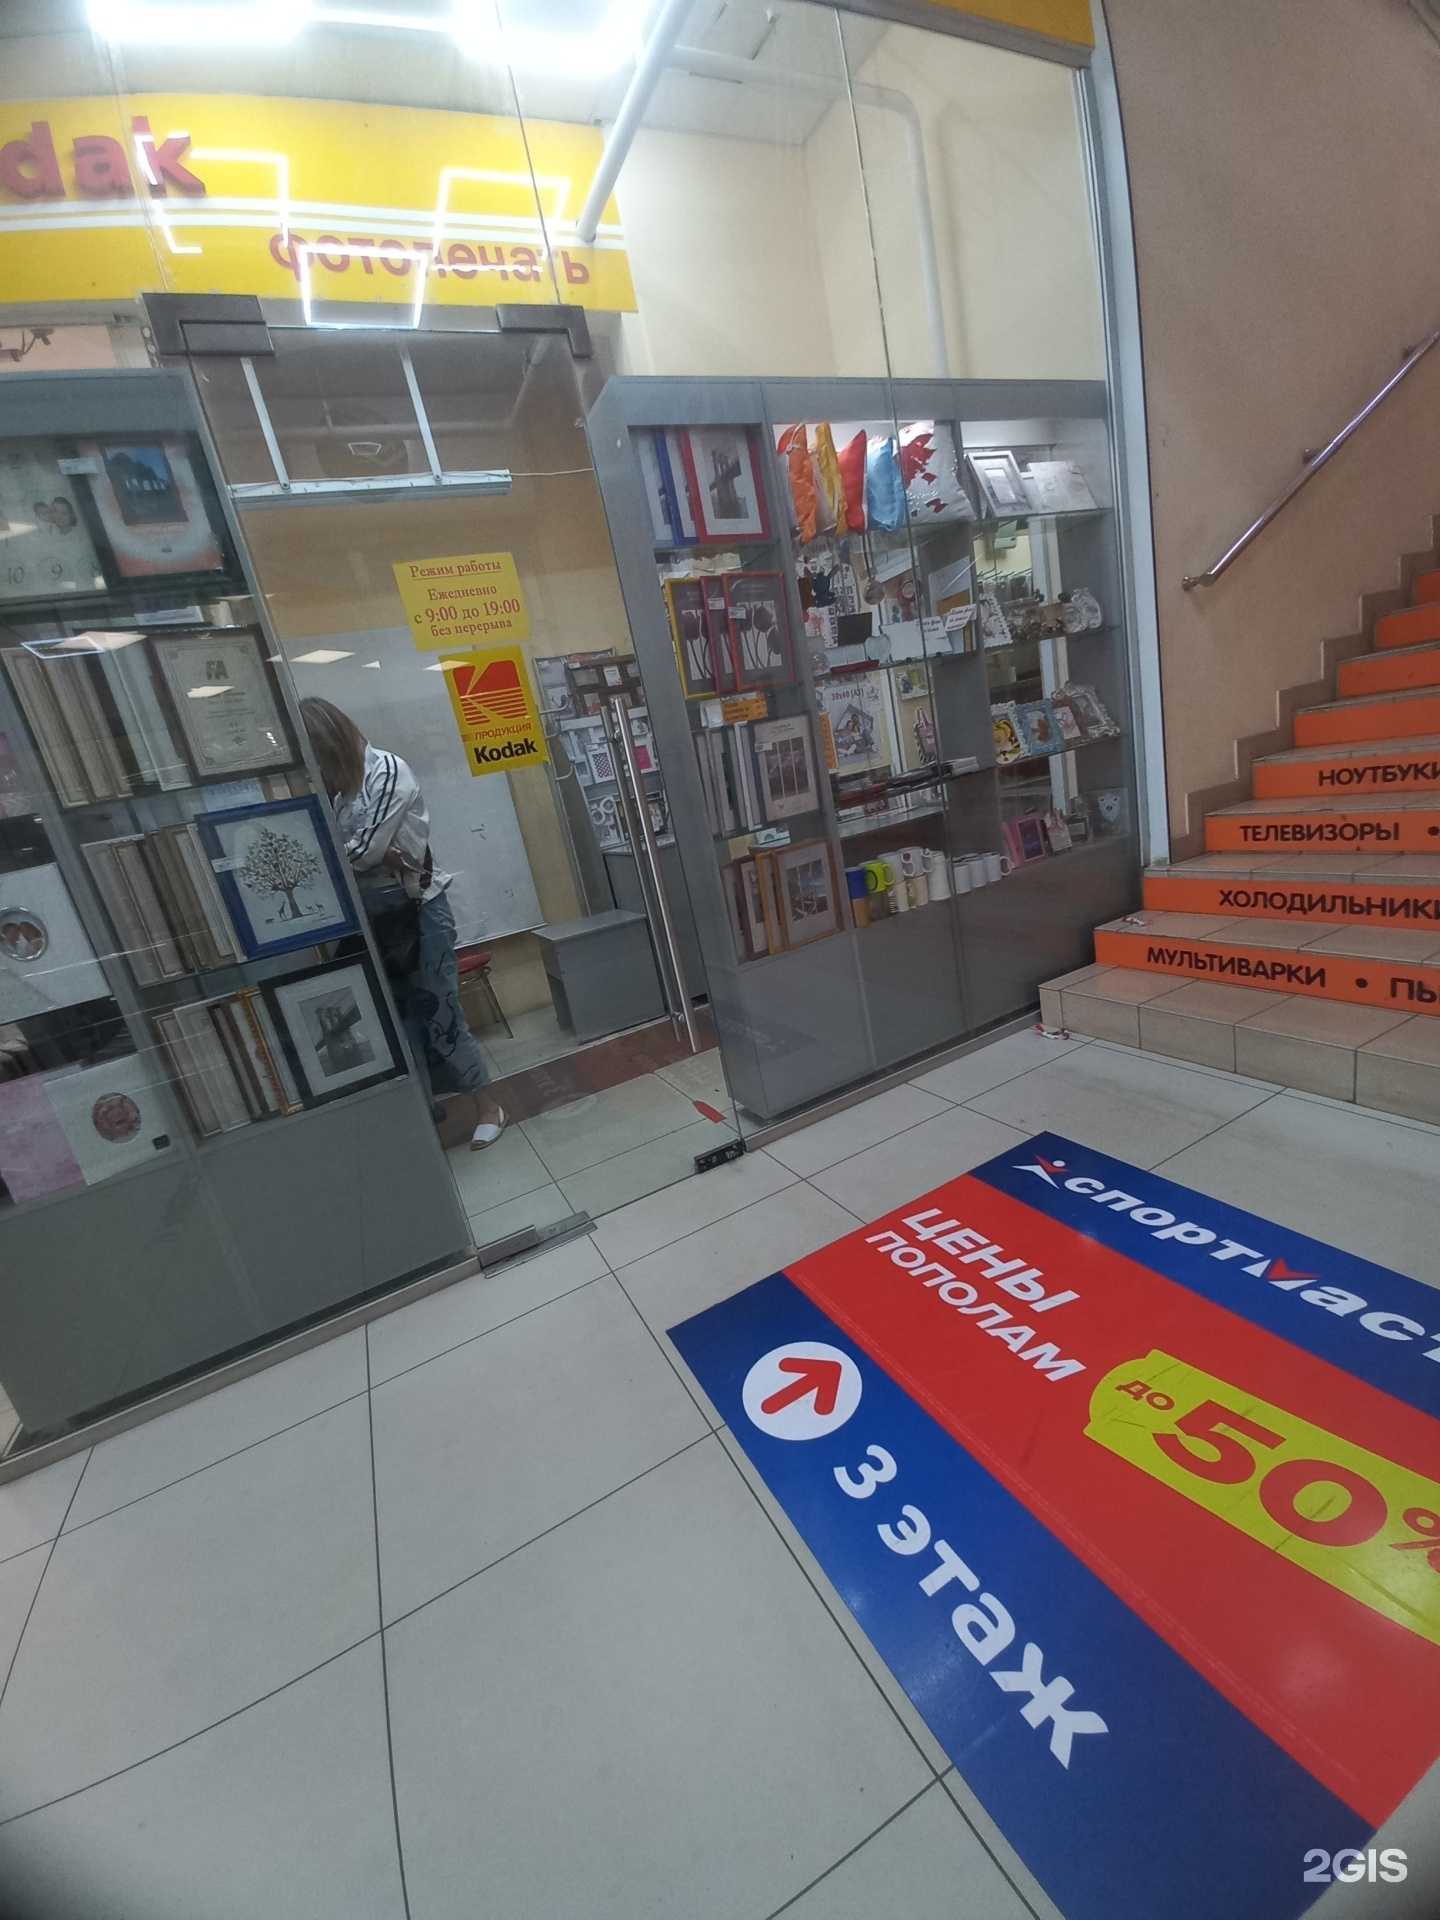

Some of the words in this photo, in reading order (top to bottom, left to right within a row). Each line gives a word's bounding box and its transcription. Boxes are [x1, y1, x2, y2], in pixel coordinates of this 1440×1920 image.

[408, 563, 454, 578] Режим
[456, 560, 502, 577] работы
[427, 585, 497, 601] Ежедневно
[413, 613, 422, 624] с
[425, 606, 458, 623] 9:00
[462, 607, 480, 620] до
[483, 599, 521, 616] 19:00
[431, 625, 452, 637] без
[454, 619, 513, 636] перерыва
[474, 737, 538, 764] Kodak
[1240, 822, 1400, 842] ТЕЛЕВИЗОРЫ
[1147, 947, 1326, 988] МУЛЬТИВАРКИ
[902, 1208, 1080, 1313] ЦЕНЫ
[864, 1230, 1087, 1383] ПОПОЛАМ
[833, 1444, 898, 1499] 3
[877, 1504, 1110, 1771] этаж
